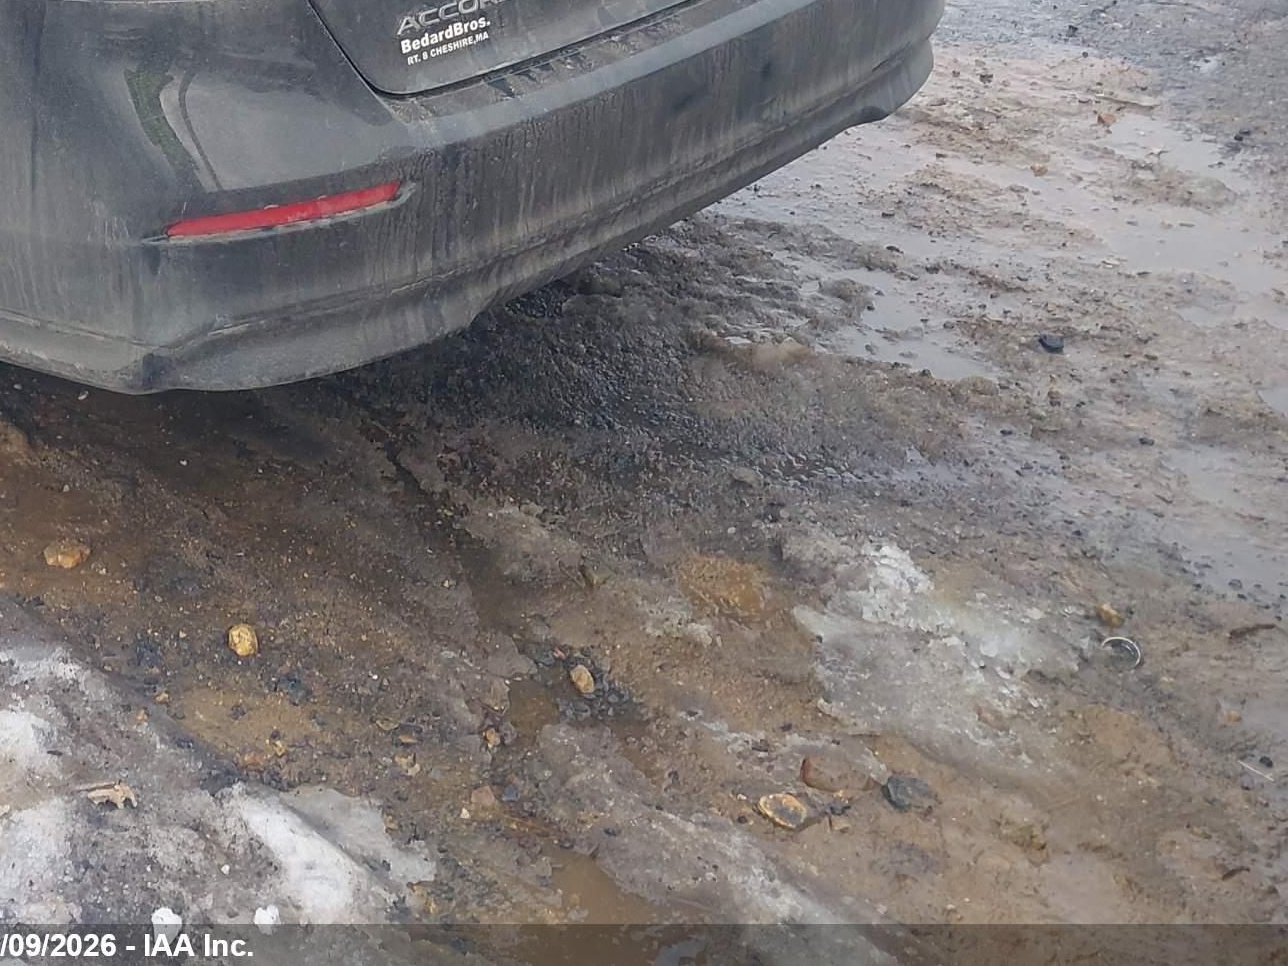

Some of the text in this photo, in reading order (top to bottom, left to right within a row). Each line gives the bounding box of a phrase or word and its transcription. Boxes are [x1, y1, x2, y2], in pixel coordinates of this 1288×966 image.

[400, 17, 491, 54] BedardBros.
[407, 54, 421, 66] RT.
[422, 51, 429, 60] 8
